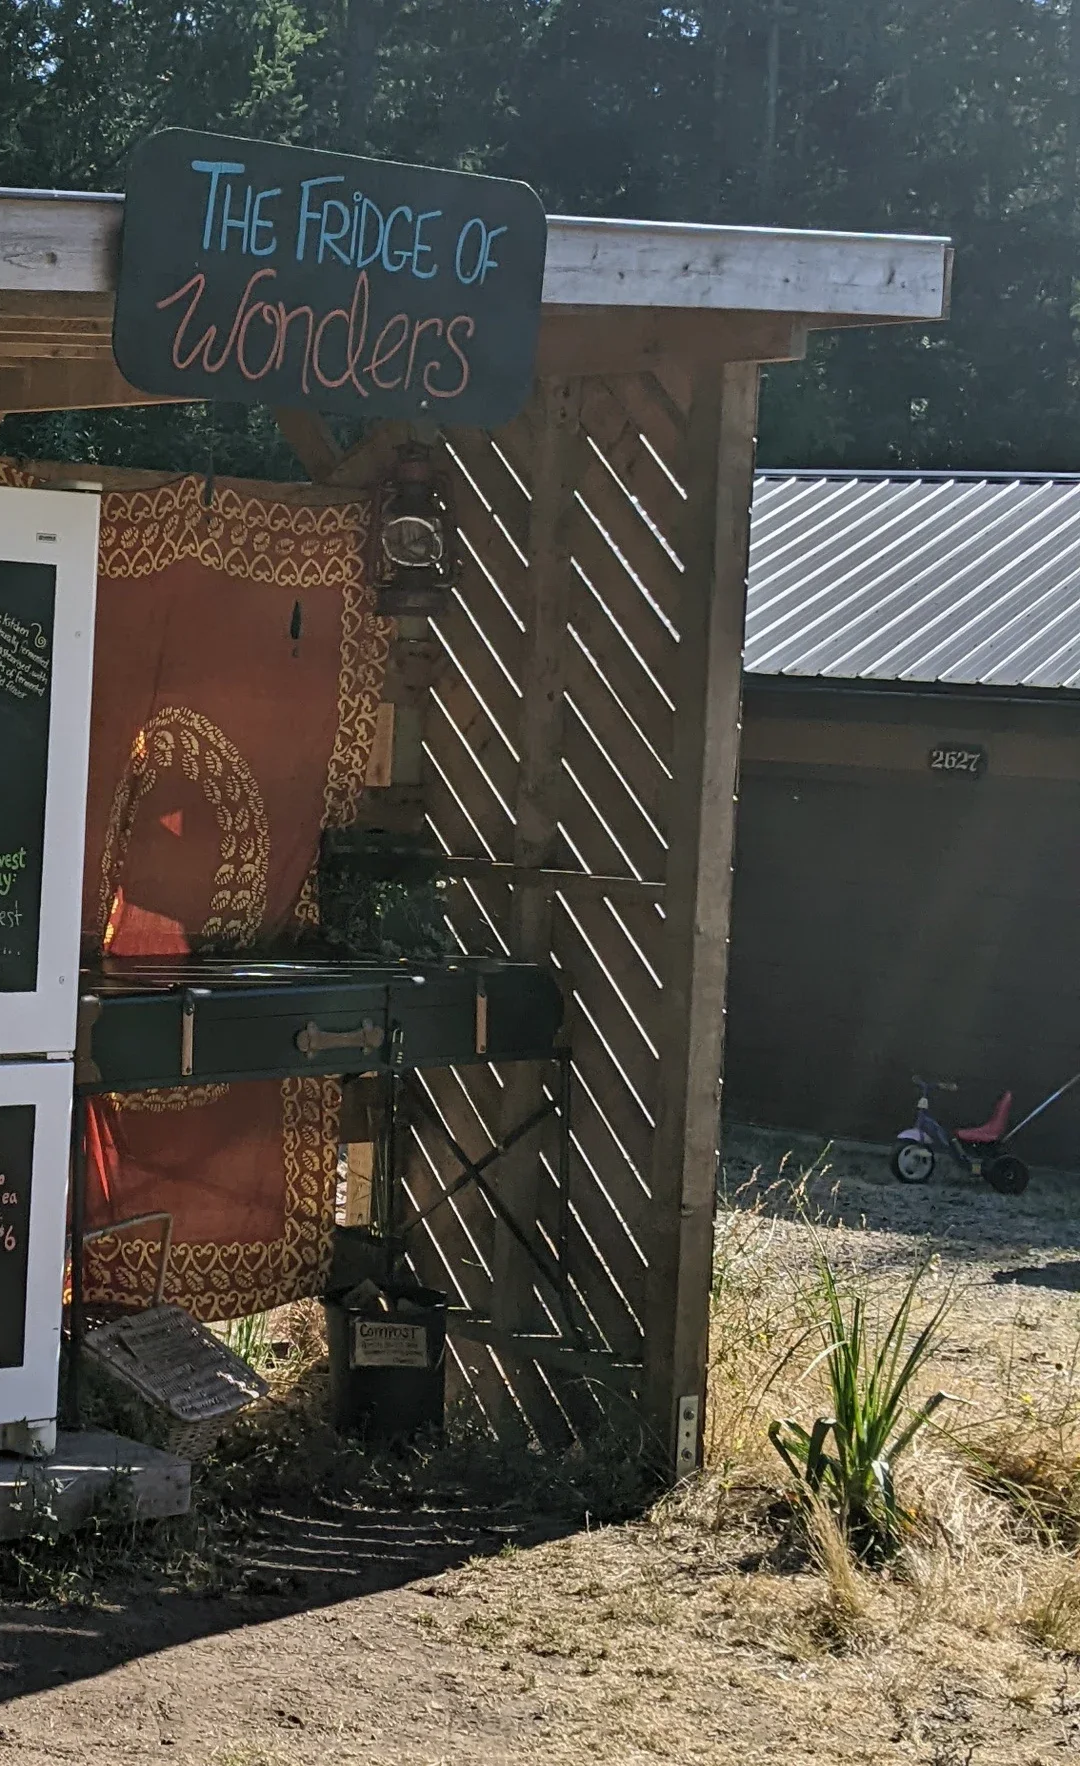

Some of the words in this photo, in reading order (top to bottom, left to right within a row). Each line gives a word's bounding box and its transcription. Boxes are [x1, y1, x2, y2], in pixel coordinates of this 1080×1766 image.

[190, 160, 283, 257] THE
[455, 217, 509, 286] OF
[156, 267, 476, 400] Wonders
[931, 750, 981, 772] 2627
[2, 1192, 18, 1204] ea
